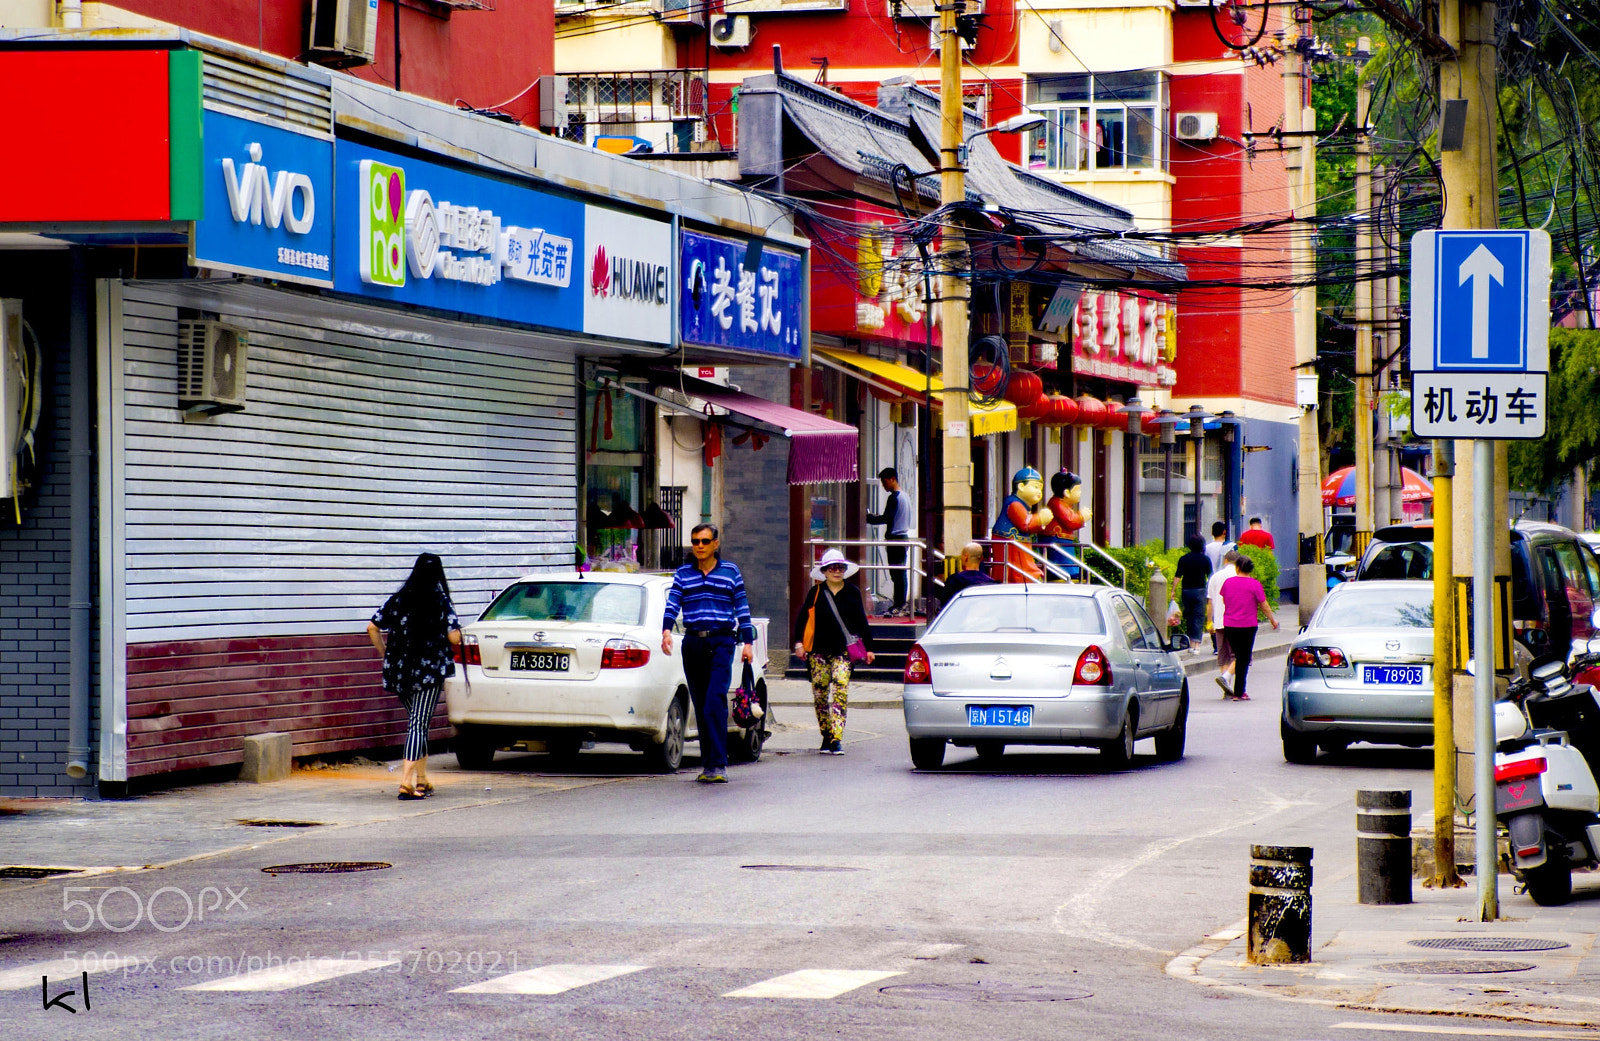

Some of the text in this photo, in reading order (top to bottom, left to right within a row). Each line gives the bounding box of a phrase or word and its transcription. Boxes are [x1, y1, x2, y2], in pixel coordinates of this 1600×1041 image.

[221, 142, 315, 235] vivo
[527, 231, 568, 281] 光宽带
[612, 255, 669, 305] HUAWEI
[711, 256, 782, 337] 老翟记
[1423, 386, 1537, 425] 机动车
